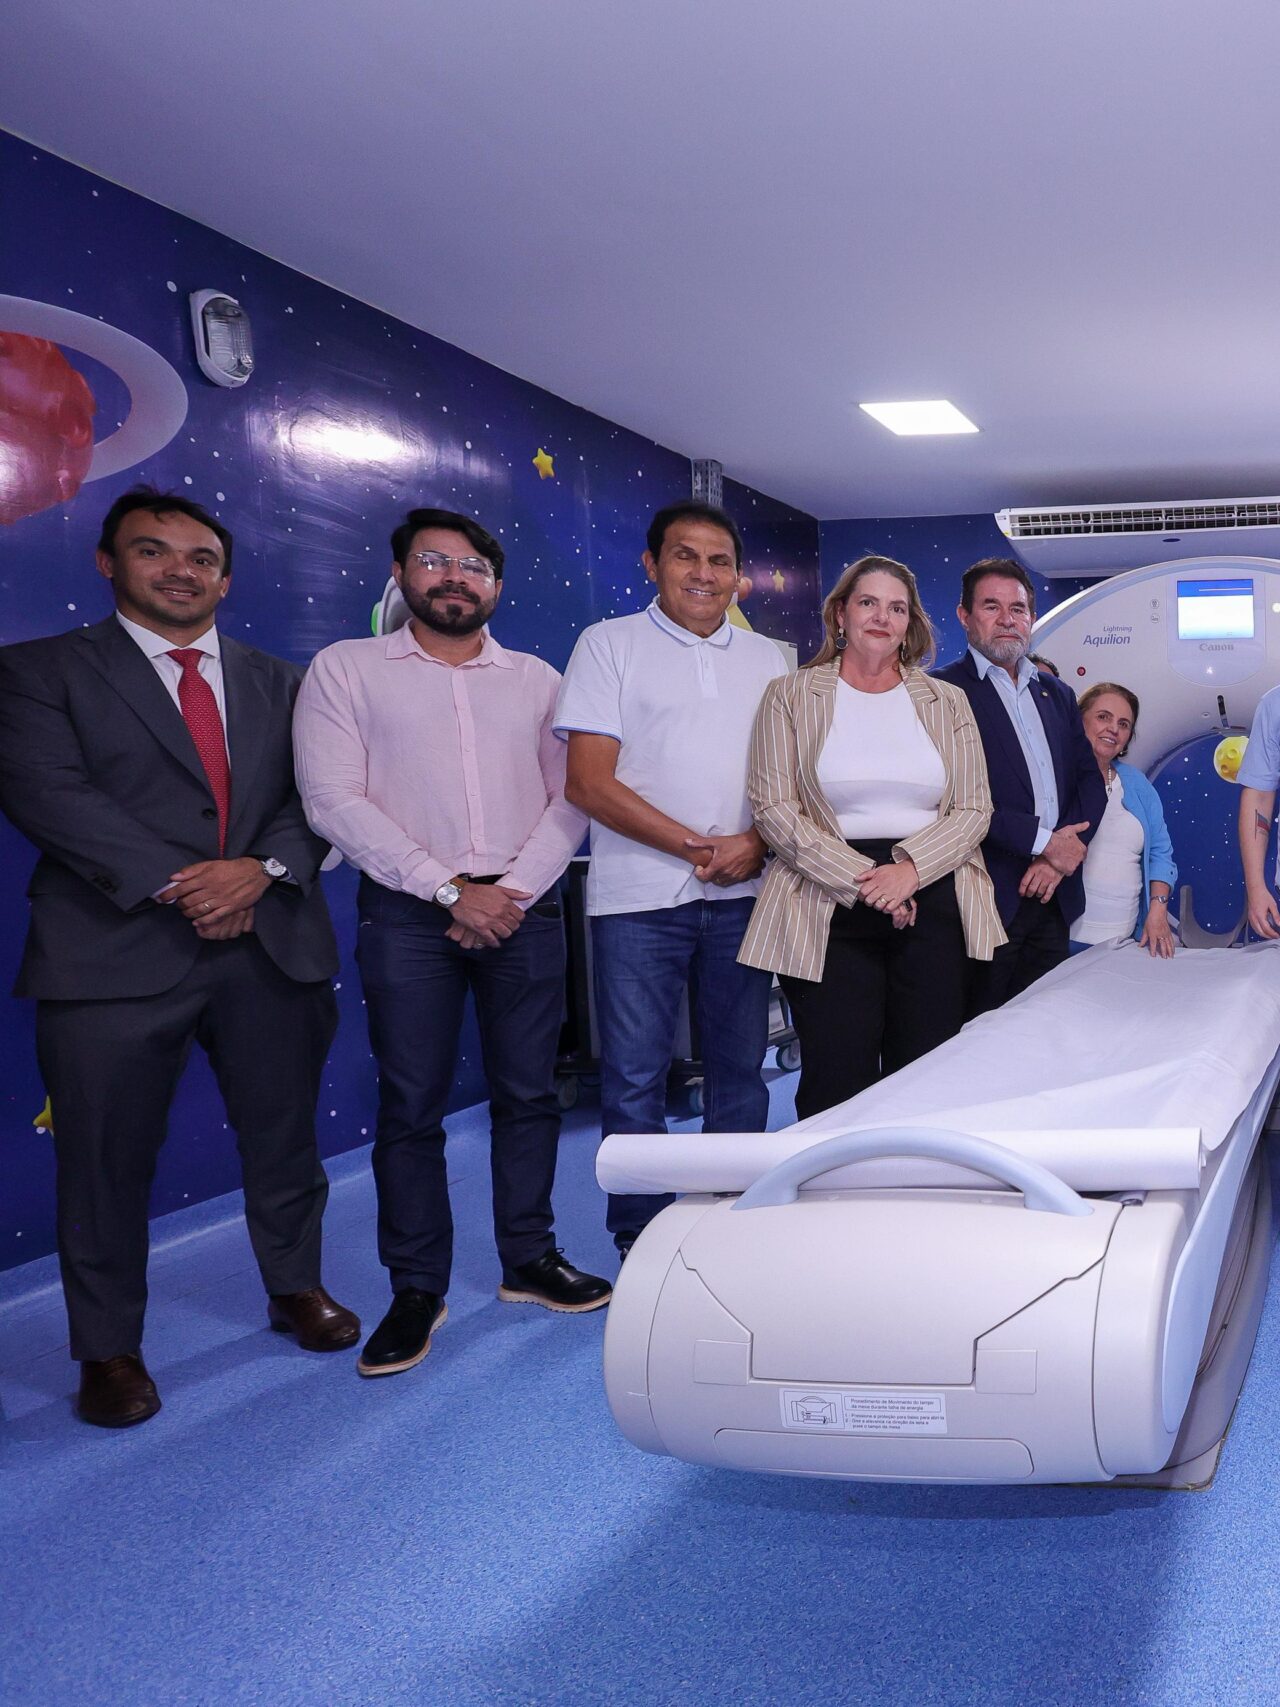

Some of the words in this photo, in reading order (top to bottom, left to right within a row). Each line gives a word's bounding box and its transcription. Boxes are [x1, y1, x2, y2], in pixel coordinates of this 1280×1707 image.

[1103, 625, 1133, 633] Lightning
[1083, 634, 1130, 647] Aquilion
[1199, 643, 1234, 651] Canon
